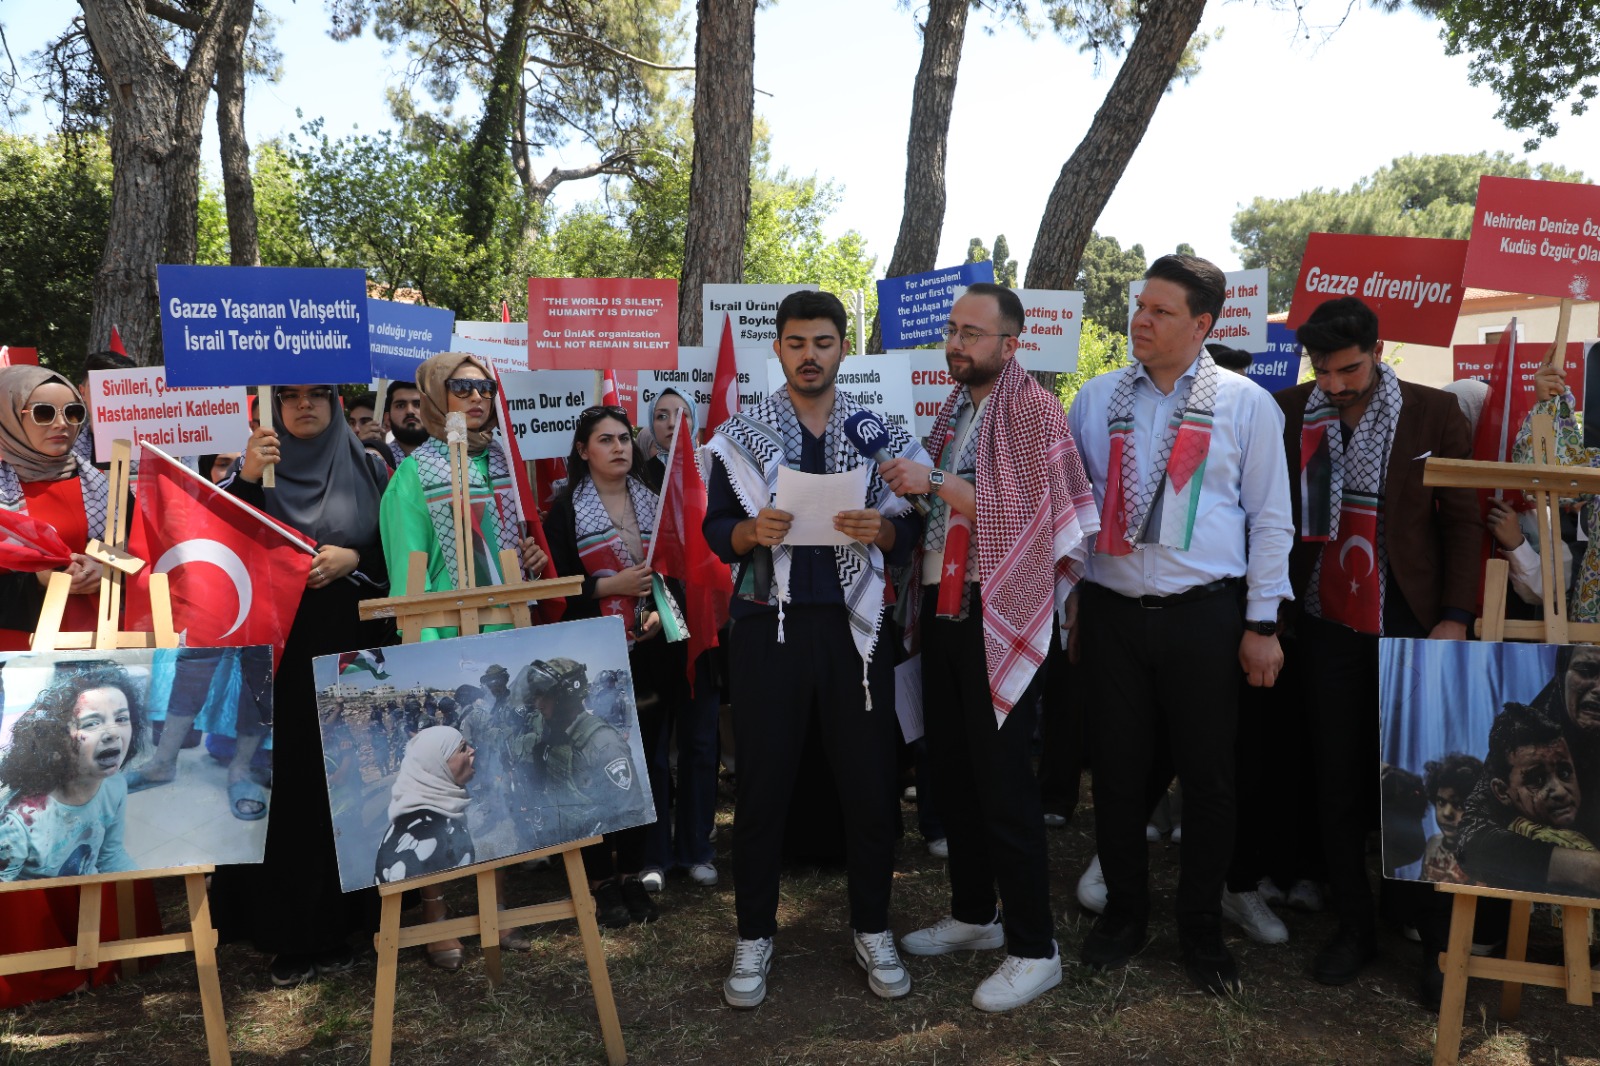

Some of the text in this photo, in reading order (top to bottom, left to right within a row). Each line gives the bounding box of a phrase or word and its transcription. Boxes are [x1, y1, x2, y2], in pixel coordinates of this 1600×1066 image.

[1483, 211, 1536, 231] Nehirden
[1539, 216, 1579, 235] Denize
[1500, 237, 1600, 262] Kudüs Özgür Ola
[905, 271, 961, 290] For Jerusalem!
[1305, 266, 1452, 308] Gazze direniyor.
[901, 294, 912, 303] For
[915, 292, 927, 300] our
[929, 287, 945, 298] first
[1238, 284, 1258, 297] that
[625, 298, 663, 307] SILENT,
[710, 299, 779, 311] İsrail Ürünl
[898, 307, 910, 315] the
[912, 302, 940, 313] Al-Aqsa
[169, 297, 360, 324] Gazze Yaşanan Vahşettir,
[621, 309, 658, 317] DYING"
[1025, 307, 1073, 321] otting to
[739, 315, 777, 327] Boyko
[902, 313, 950, 328] For our Pales
[376, 323, 406, 340] olduğu
[408, 328, 433, 342] yerde
[542, 330, 562, 338] Our
[598, 330, 660, 339] organization
[740, 329, 777, 341] #Saysto
[900, 329, 932, 340] brothers
[1031, 323, 1063, 335] death
[1208, 324, 1250, 341] ospitals.
[184, 325, 351, 355] İsrail Terör Örgütüdür.
[536, 340, 561, 348] WILL
[633, 341, 670, 349] SILENT
[1457, 362, 1480, 370] The
[1566, 361, 1577, 369] is
[692, 368, 714, 382] Olan
[102, 378, 152, 397] Sivilleri,
[539, 393, 561, 409] Dur
[565, 391, 585, 406] de!
[97, 399, 240, 423] Hastahaneleri Katleden
[177, 423, 213, 443] İsrail.
